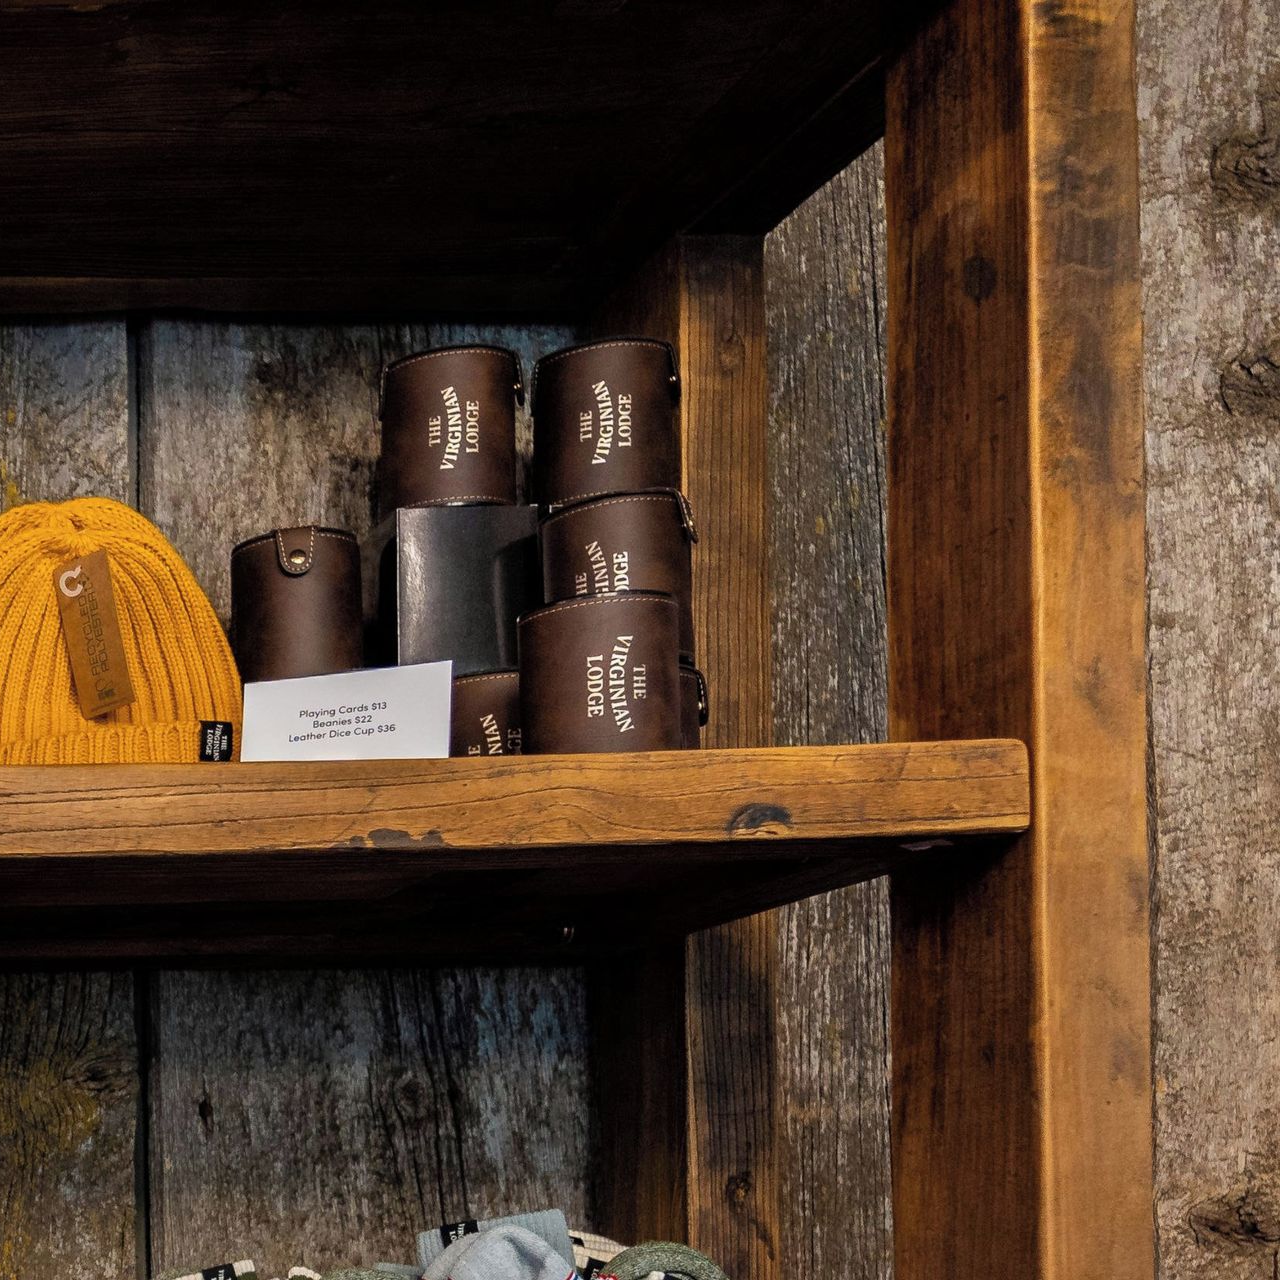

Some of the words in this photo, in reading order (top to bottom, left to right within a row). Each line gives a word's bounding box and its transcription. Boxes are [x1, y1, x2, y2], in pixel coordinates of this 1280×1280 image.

[429, 416, 441, 447] THE
[440, 386, 462, 469] VIRGINIAN
[466, 400, 479, 453] LODGE
[580, 410, 592, 442] THE
[592, 380, 614, 464] VIRGINIAN
[619, 394, 631, 447] LODGE
[586, 654, 604, 718] LODGE
[609, 635, 636, 733] VIRGINIAN
[633, 664, 647, 699] THE
[299, 708, 336, 719] Playing
[338, 704, 369, 715] Cards
[371, 701, 388, 711] $13
[312, 718, 352, 729] Beanies
[354, 715, 373, 725] $22
[288, 731, 326, 743] Leather
[329, 728, 351, 739] Dice
[353, 726, 375, 737] Cup
[377, 724, 396, 734] $36
